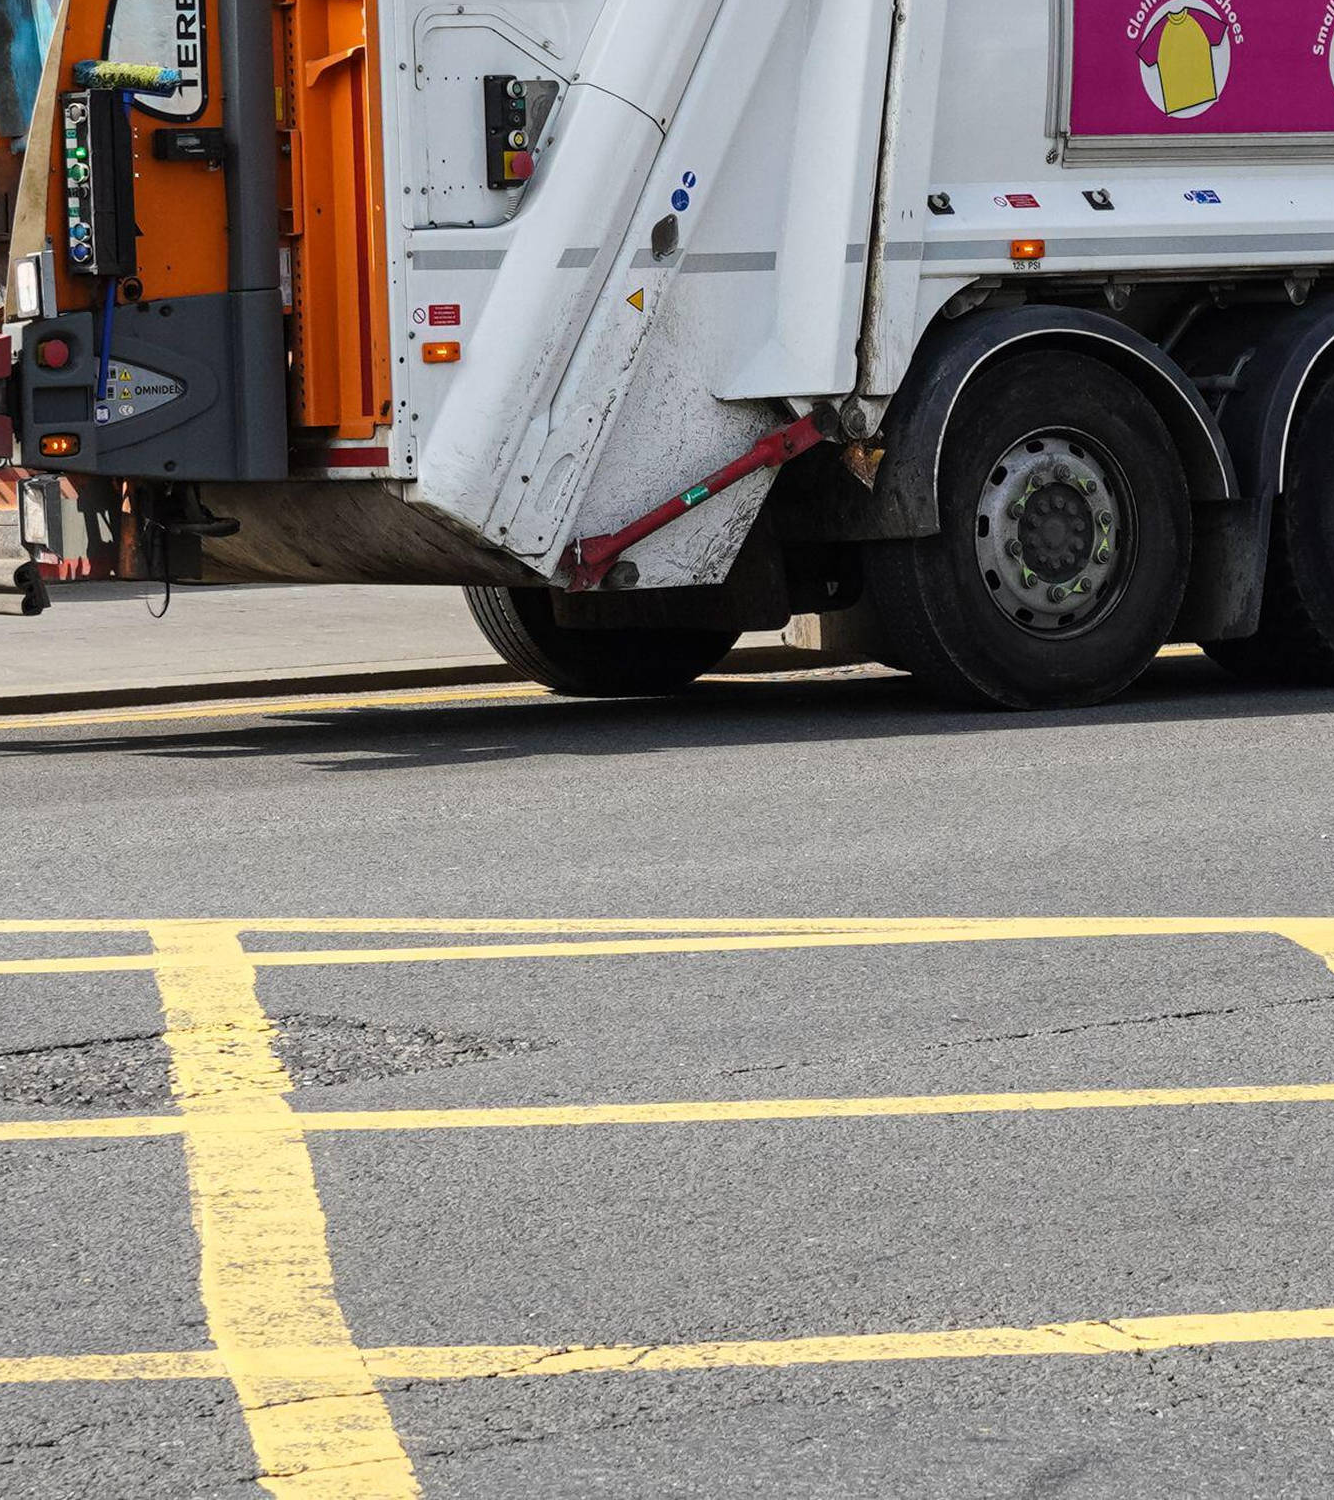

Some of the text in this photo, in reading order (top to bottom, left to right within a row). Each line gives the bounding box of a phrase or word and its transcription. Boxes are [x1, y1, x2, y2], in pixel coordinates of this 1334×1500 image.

[1012, 261, 1041, 270] 125 PSI
[134, 384, 180, 396] OMNIDEL
